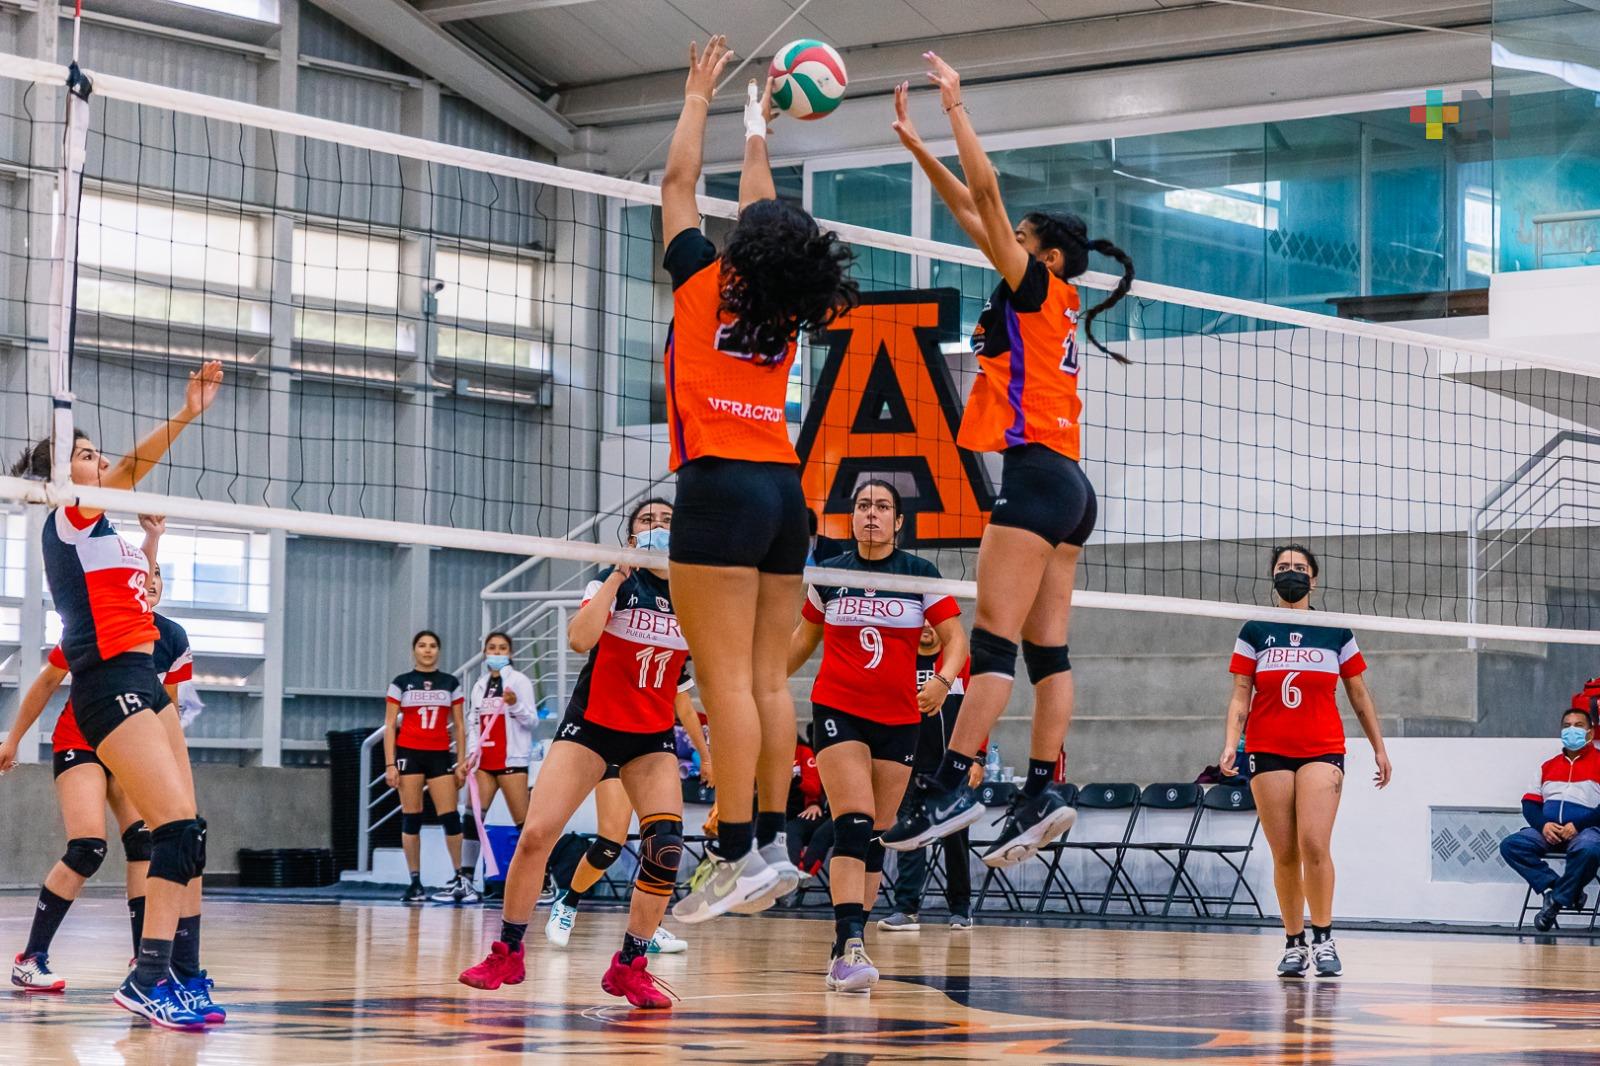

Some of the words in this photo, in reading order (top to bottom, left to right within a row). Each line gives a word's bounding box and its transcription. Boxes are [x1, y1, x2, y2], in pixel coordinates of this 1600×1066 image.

[708, 397, 782, 422] VERACRU
[796, 286, 1000, 549] A
[837, 599, 904, 617] IBERO
[627, 607, 681, 638] IBER
[859, 626, 884, 669] 9
[1266, 649, 1324, 663] IBERO
[636, 646, 674, 688] 11
[410, 691, 447, 701] IBERO
[1281, 671, 1303, 709] 6
[417, 707, 440, 729] 17
[824, 719, 838, 737] 9
